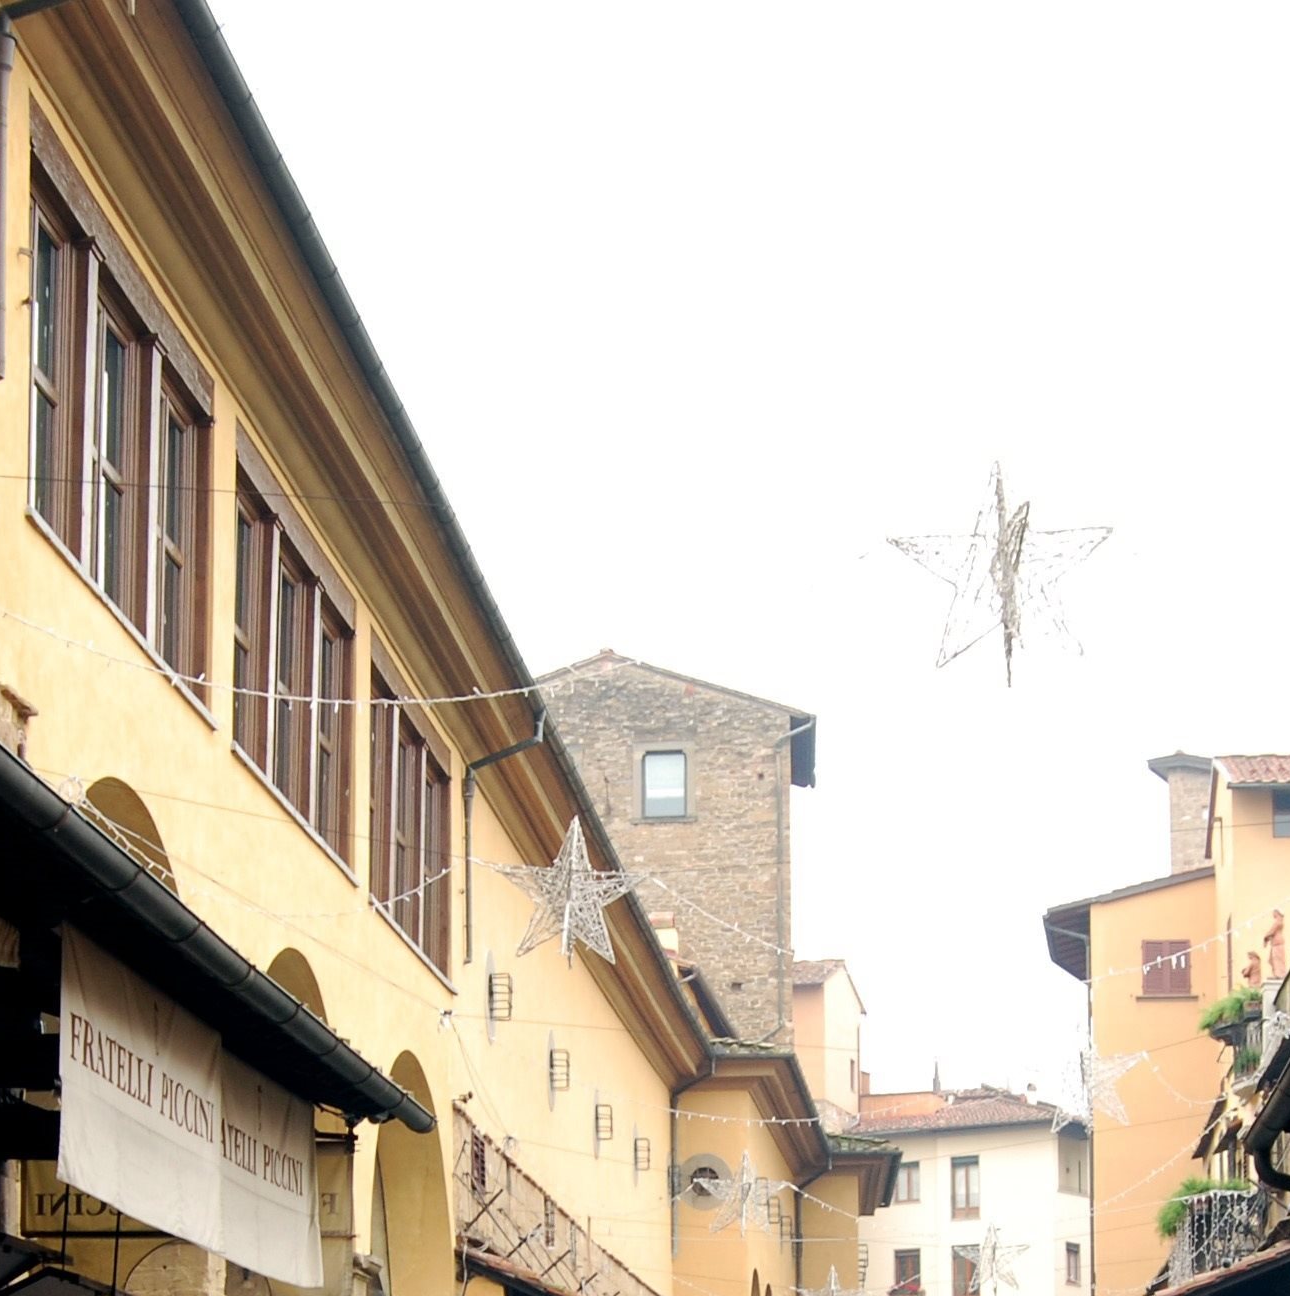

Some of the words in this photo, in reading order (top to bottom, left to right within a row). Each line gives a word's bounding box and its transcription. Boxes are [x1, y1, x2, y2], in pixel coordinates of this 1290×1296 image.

[69, 1011, 155, 1109] FRATELLI
[159, 1071, 215, 1145] PICCINI
[262, 1143, 303, 1197] PICCINI
